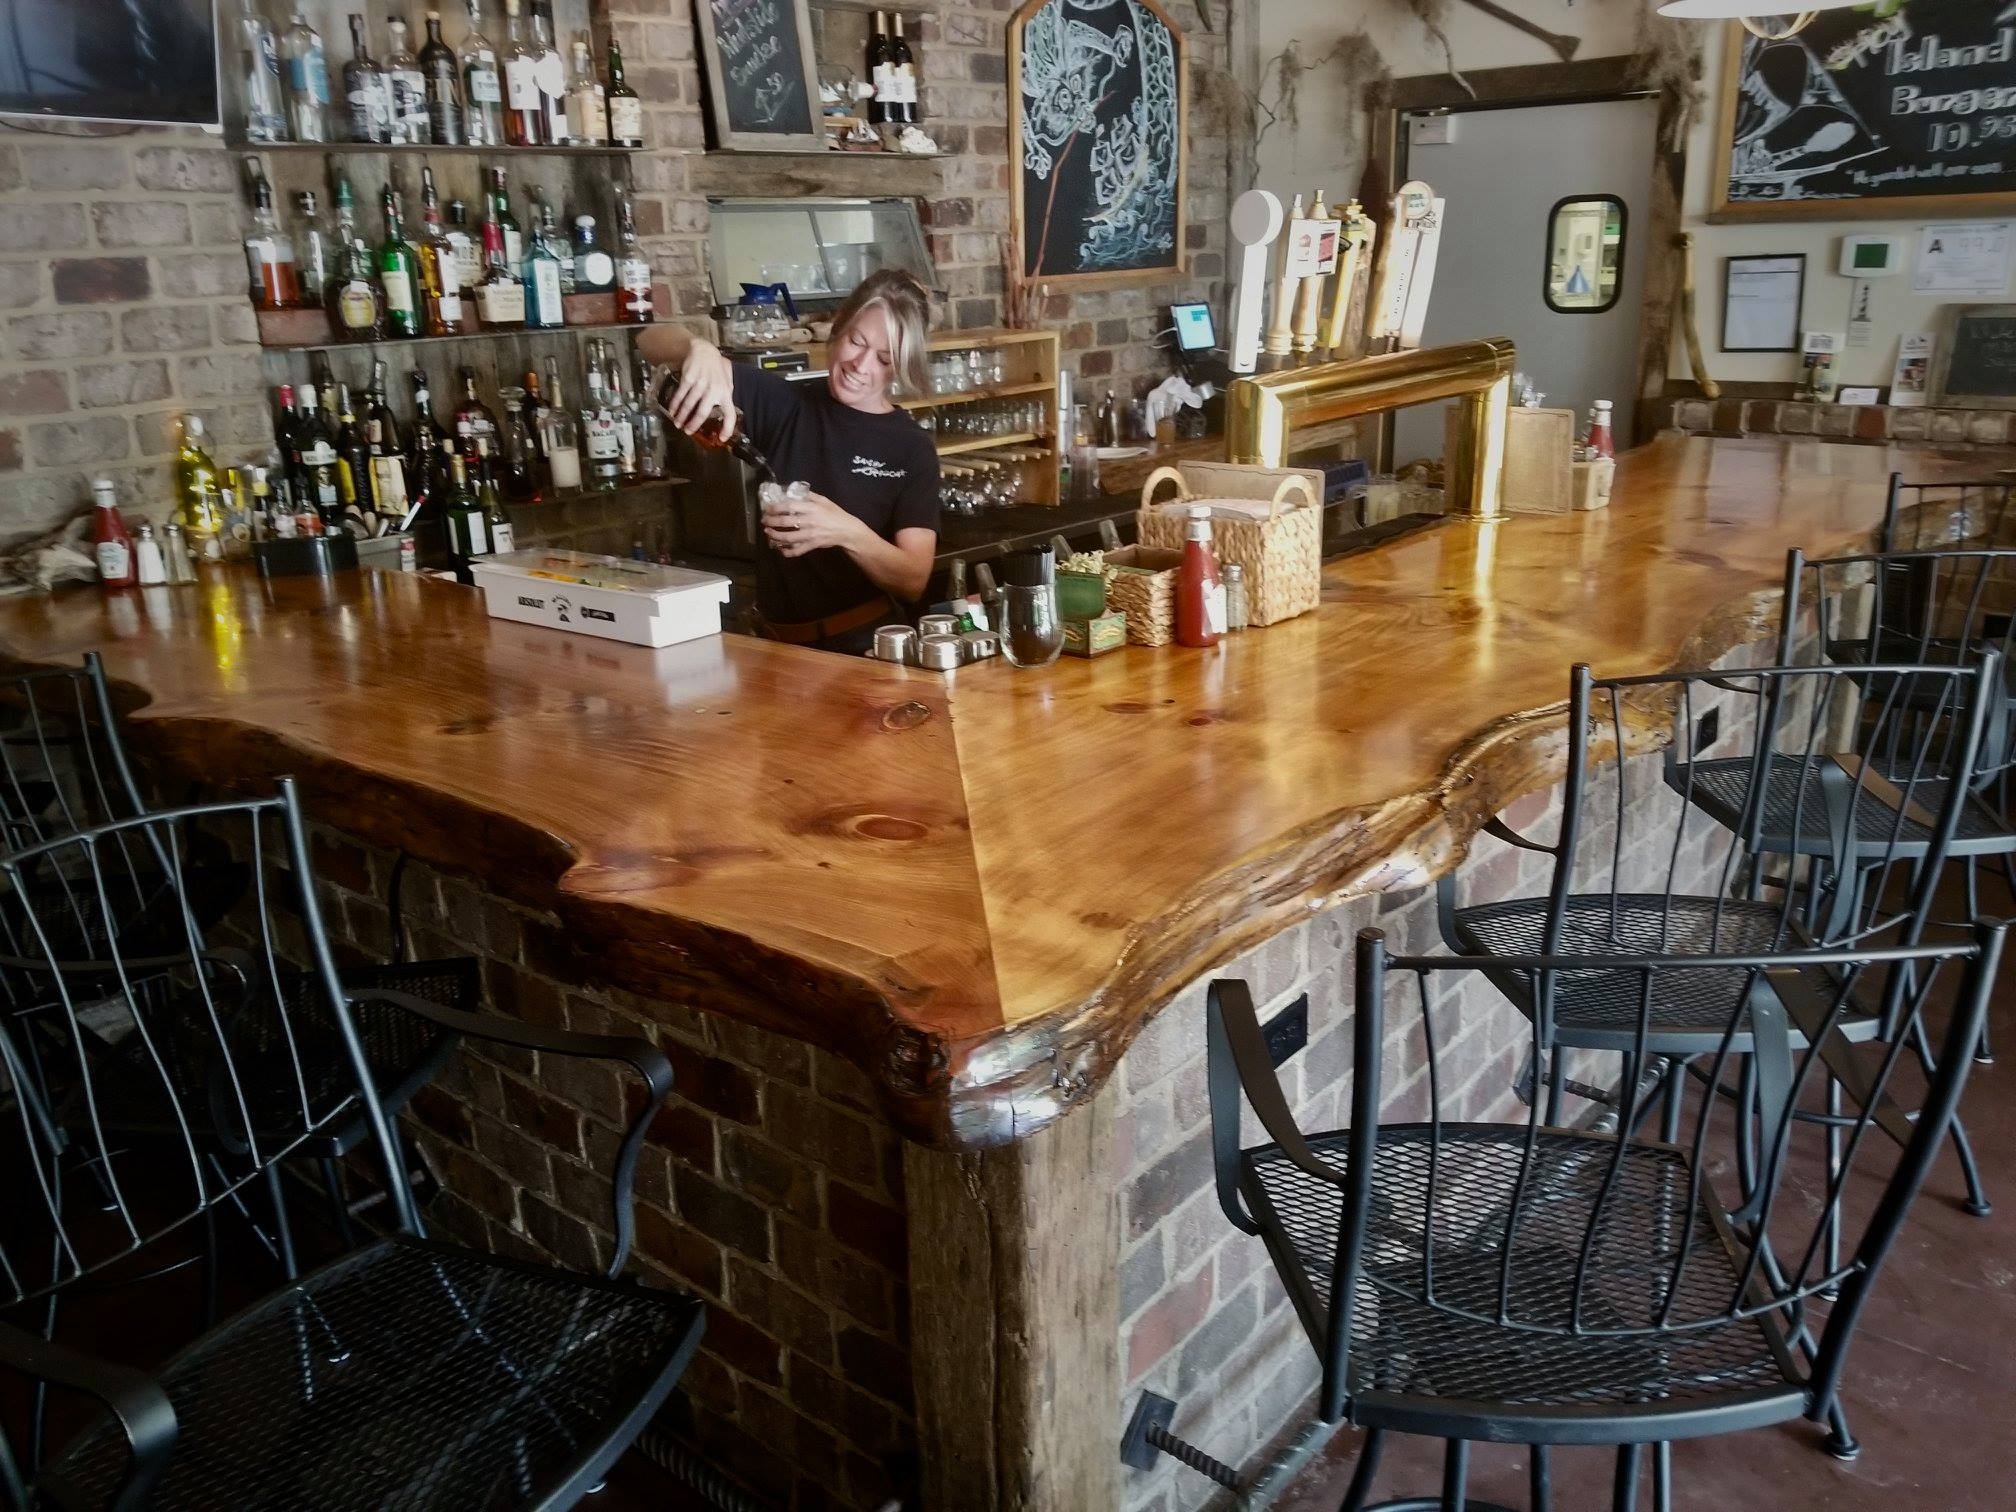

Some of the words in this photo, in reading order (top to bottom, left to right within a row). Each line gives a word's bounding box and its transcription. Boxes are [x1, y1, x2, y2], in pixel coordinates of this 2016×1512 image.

[1886, 27, 2015, 75] Island
[1891, 85, 2016, 115] Burger
[1928, 239, 1943, 254] A
